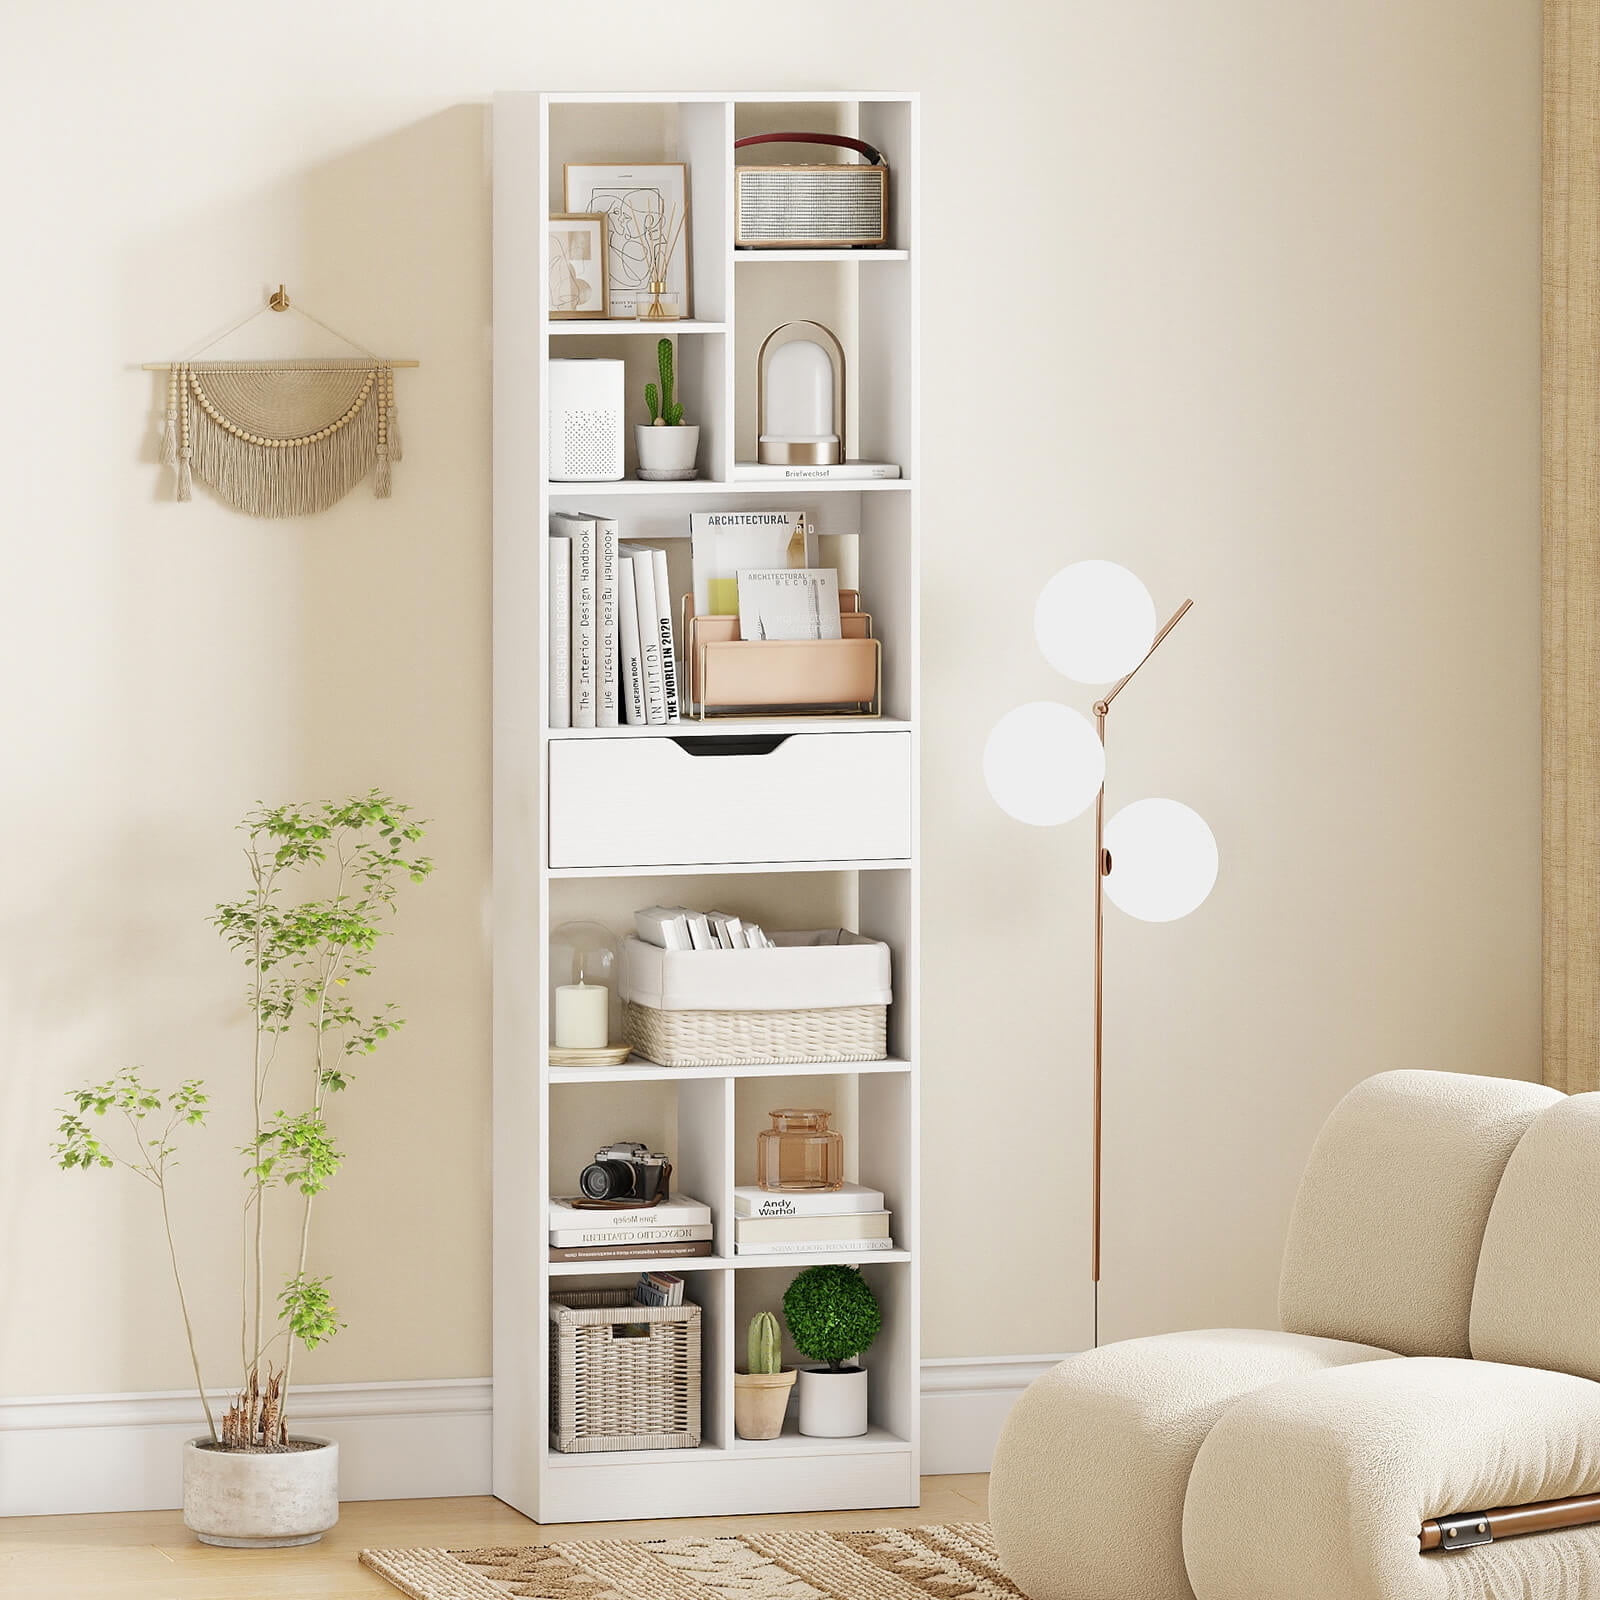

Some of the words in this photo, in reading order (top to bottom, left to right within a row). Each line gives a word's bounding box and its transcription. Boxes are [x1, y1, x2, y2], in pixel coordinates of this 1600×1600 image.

[708, 514, 789, 526] ARCHITECTURAL
[580, 529, 590, 581] Handbook
[748, 572, 807, 581] ARCHITECTURAL
[580, 588, 592, 627] Design
[660, 618, 671, 645] 2020
[580, 633, 590, 684] Interior
[663, 648, 673, 659] IN
[556, 634, 567, 699] HOUSEHOLD
[646, 644, 662, 720] INTUITION
[664, 661, 676, 699] WORLD
[580, 691, 590, 710] The
[668, 701, 678, 720] THE
[758, 1207, 796, 1216] Warhol
[763, 1199, 792, 1209] Andy
